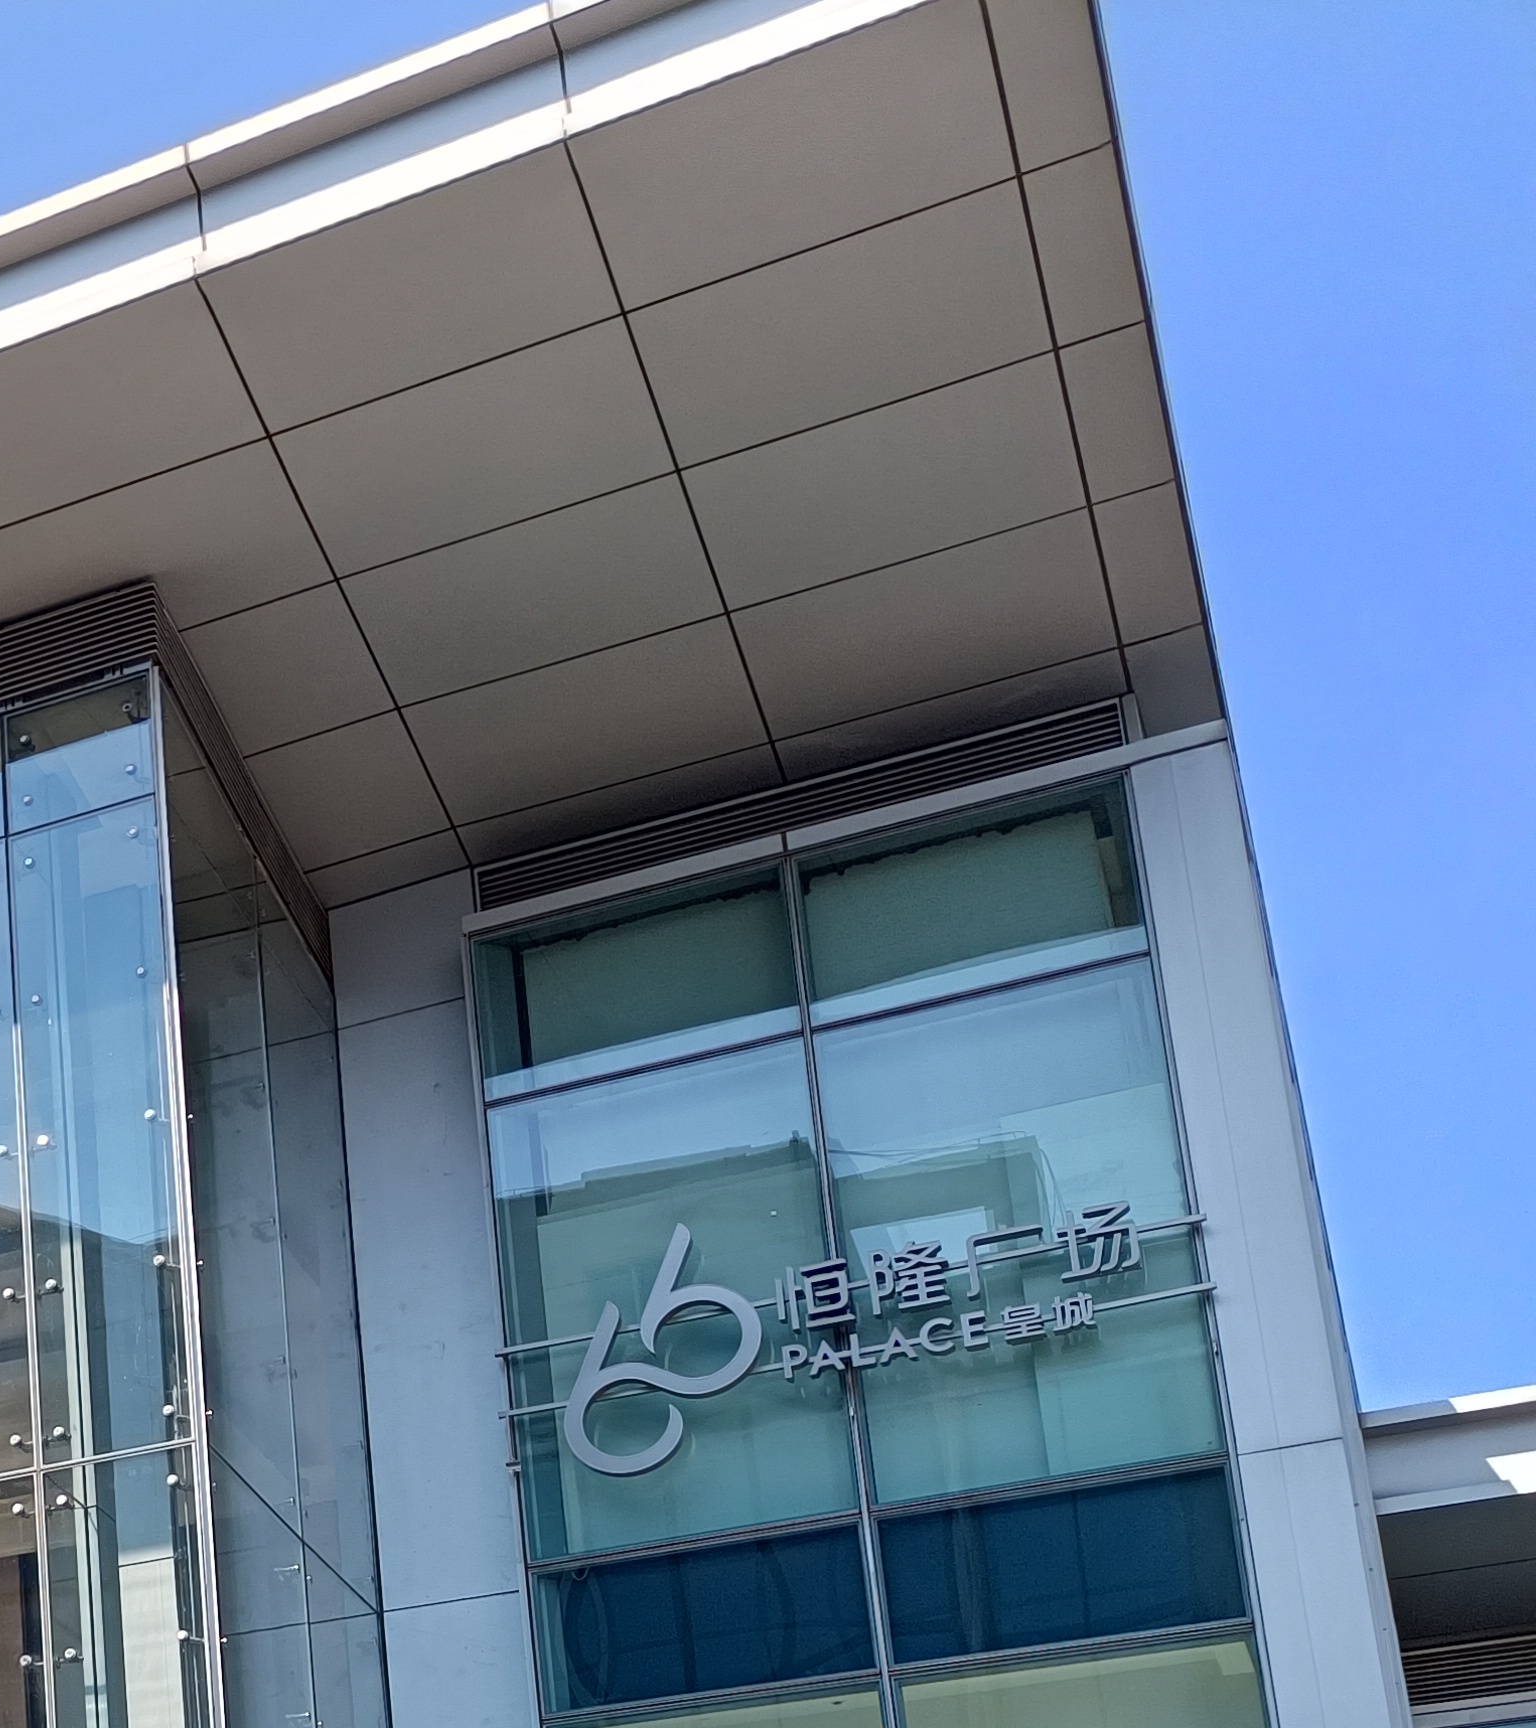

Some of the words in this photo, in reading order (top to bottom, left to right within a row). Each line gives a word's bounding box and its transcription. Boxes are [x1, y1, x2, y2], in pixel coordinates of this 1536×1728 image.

[775, 1201, 1142, 1330] 恒隆广场
[782, 1311, 989, 1379] PALACE
[1000, 1292, 1095, 1341] 皇城
